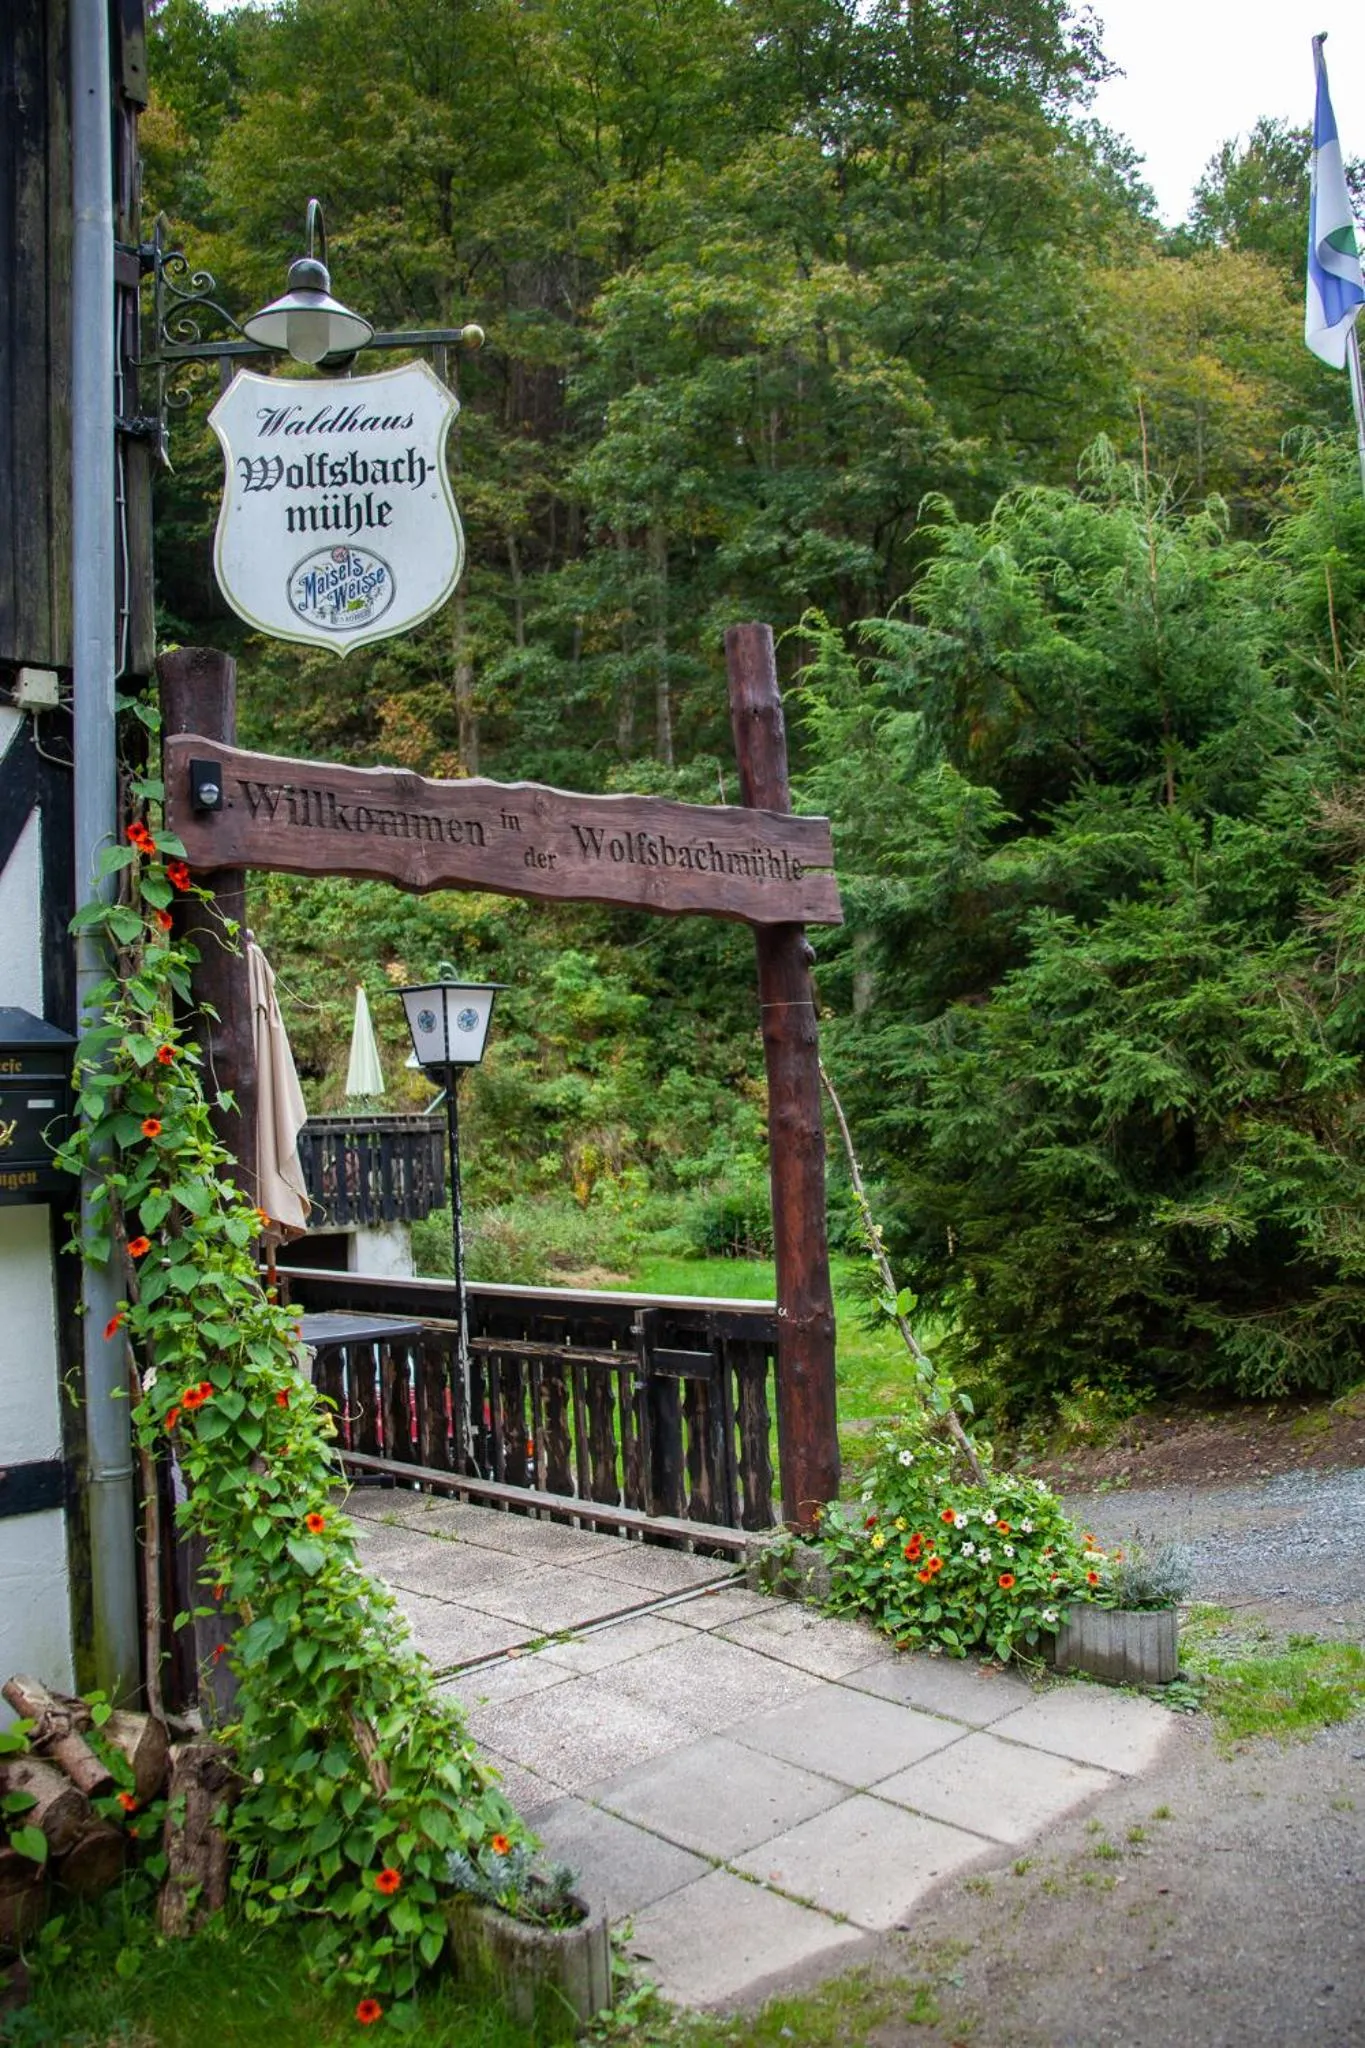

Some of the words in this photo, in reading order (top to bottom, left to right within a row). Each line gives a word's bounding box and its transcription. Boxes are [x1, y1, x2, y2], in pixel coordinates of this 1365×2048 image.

[256, 404, 414, 437] Waldhaus
[237, 447, 436, 493] Wolfsbach-
[285, 493, 393, 537] mühle
[298, 552, 364, 611] Maisel's
[327, 567, 385, 611] Weisse
[237, 779, 486, 847] Willkommen
[500, 808, 520, 831] in
[524, 847, 557, 870] der
[571, 825, 803, 882] Wolfsbachmühle
